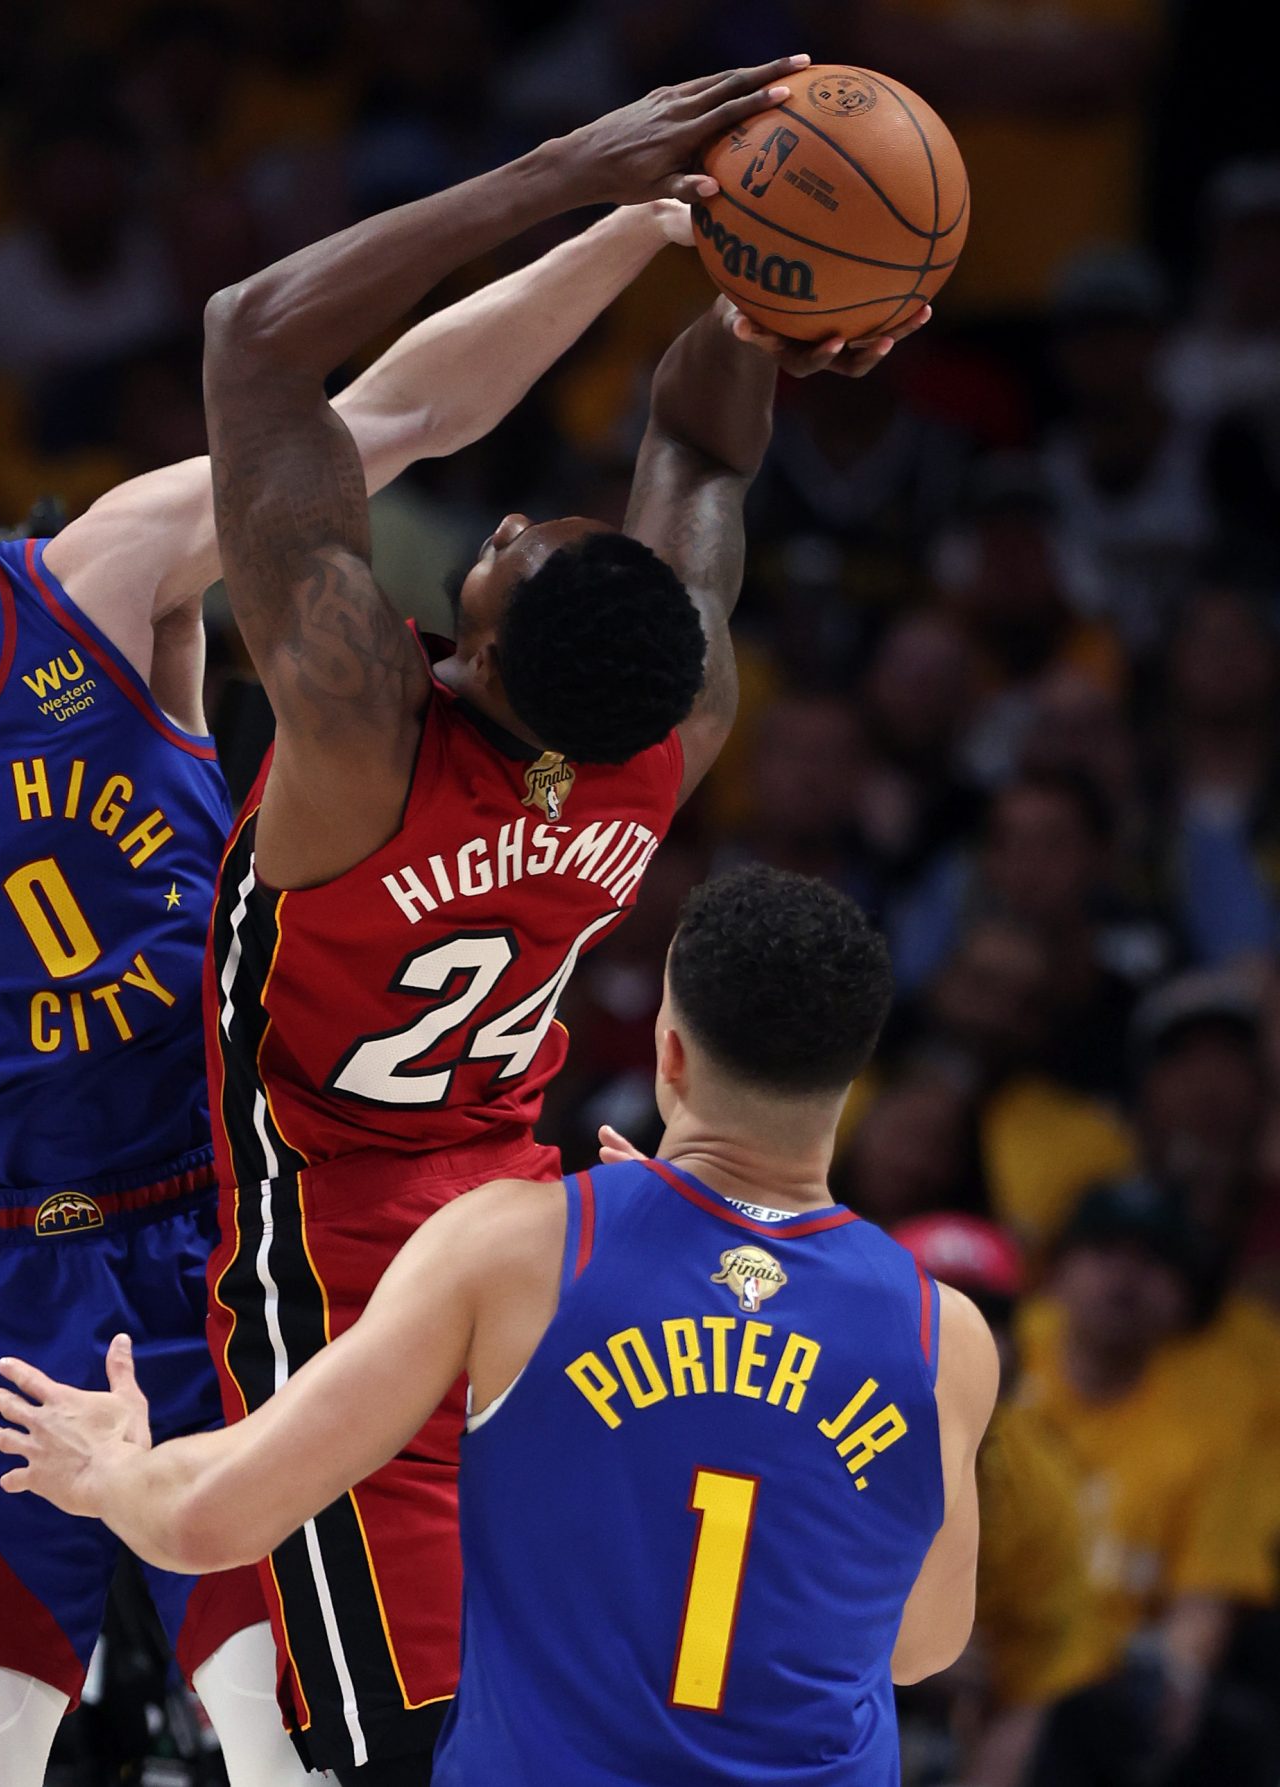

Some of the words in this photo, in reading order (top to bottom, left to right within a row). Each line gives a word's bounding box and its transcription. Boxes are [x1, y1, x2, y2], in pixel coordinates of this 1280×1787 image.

[691, 201, 818, 302] Wilso
[22, 649, 85, 699] WU
[37, 677, 97, 716] Western
[53, 693, 95, 723] Union
[11, 757, 175, 869] HIGH
[523, 762, 573, 803] Finals
[2, 857, 102, 979] 0
[381, 816, 660, 925] HIGHSMITH
[29, 953, 177, 1054] CITY
[328, 908, 623, 1110] 24
[730, 1200, 764, 1218] IKE
[714, 1254, 785, 1283] Finals
[564, 1316, 822, 1430] PORTER
[816, 1376, 909, 1492] JR.
[668, 1464, 761, 1715] 1
